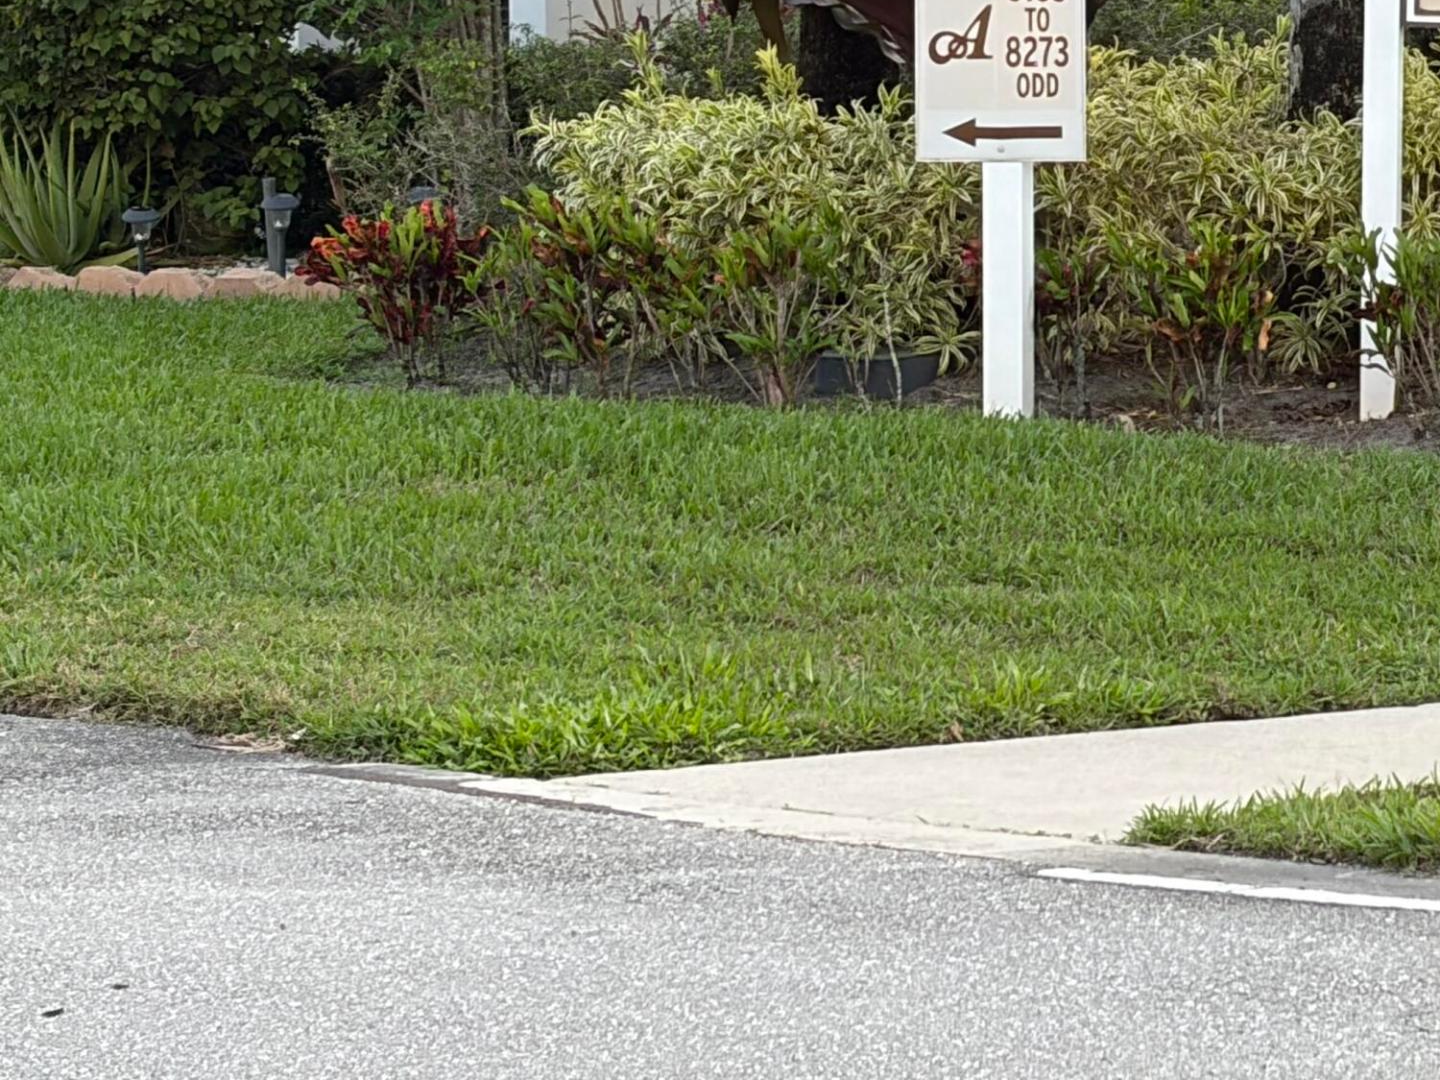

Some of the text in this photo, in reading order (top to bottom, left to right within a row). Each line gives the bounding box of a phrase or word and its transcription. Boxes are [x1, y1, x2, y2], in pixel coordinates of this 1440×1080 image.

[1025, 7, 1050, 32] TO
[928, 4, 993, 65] A
[1005, 36, 1069, 67] 8273
[1016, 73, 1059, 98] ODD
